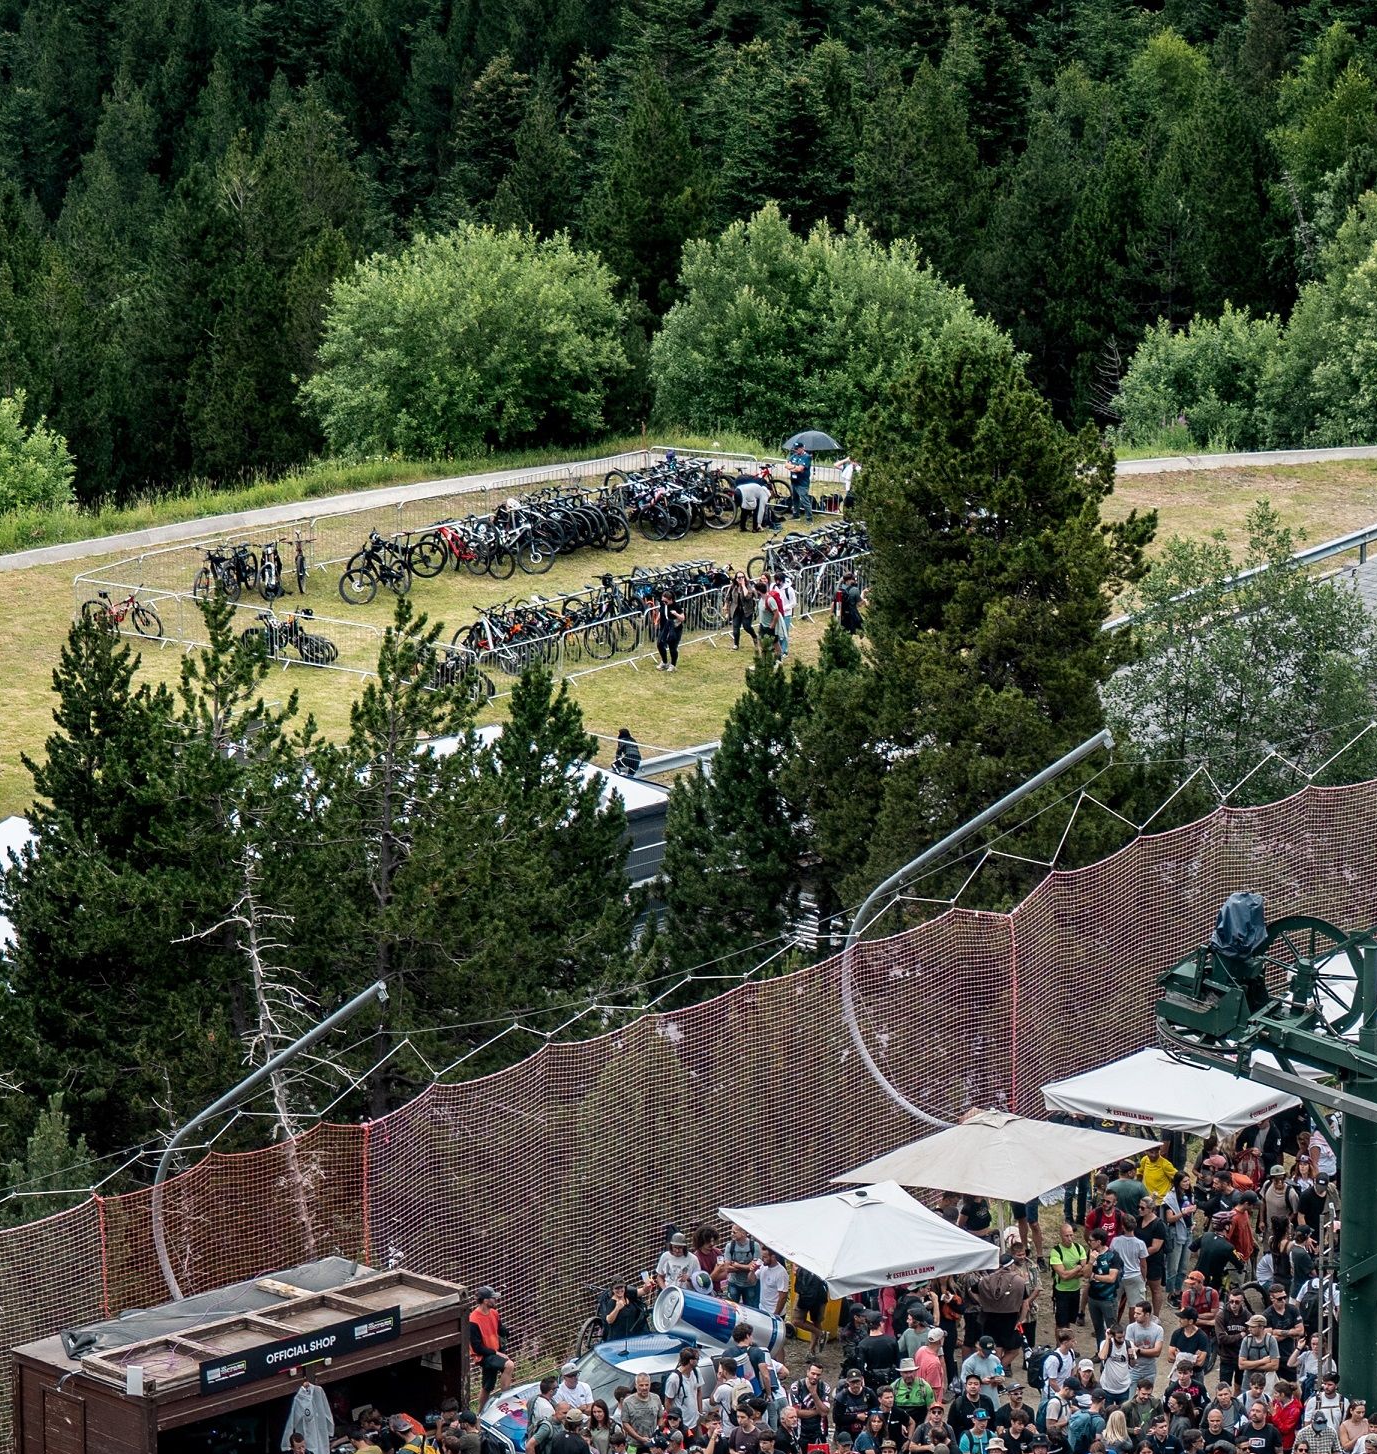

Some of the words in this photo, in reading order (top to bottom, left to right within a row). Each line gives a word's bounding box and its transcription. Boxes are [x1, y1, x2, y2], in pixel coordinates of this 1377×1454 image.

[1113, 1109, 1137, 1120] ESTRELLA
[1138, 1113, 1154, 1122] DAMM
[893, 1269, 918, 1279] ESTRELLA
[918, 1266, 935, 1275] DAMM
[266, 1345, 309, 1365] OFFICIAL
[309, 1335, 337, 1352] SHOP
